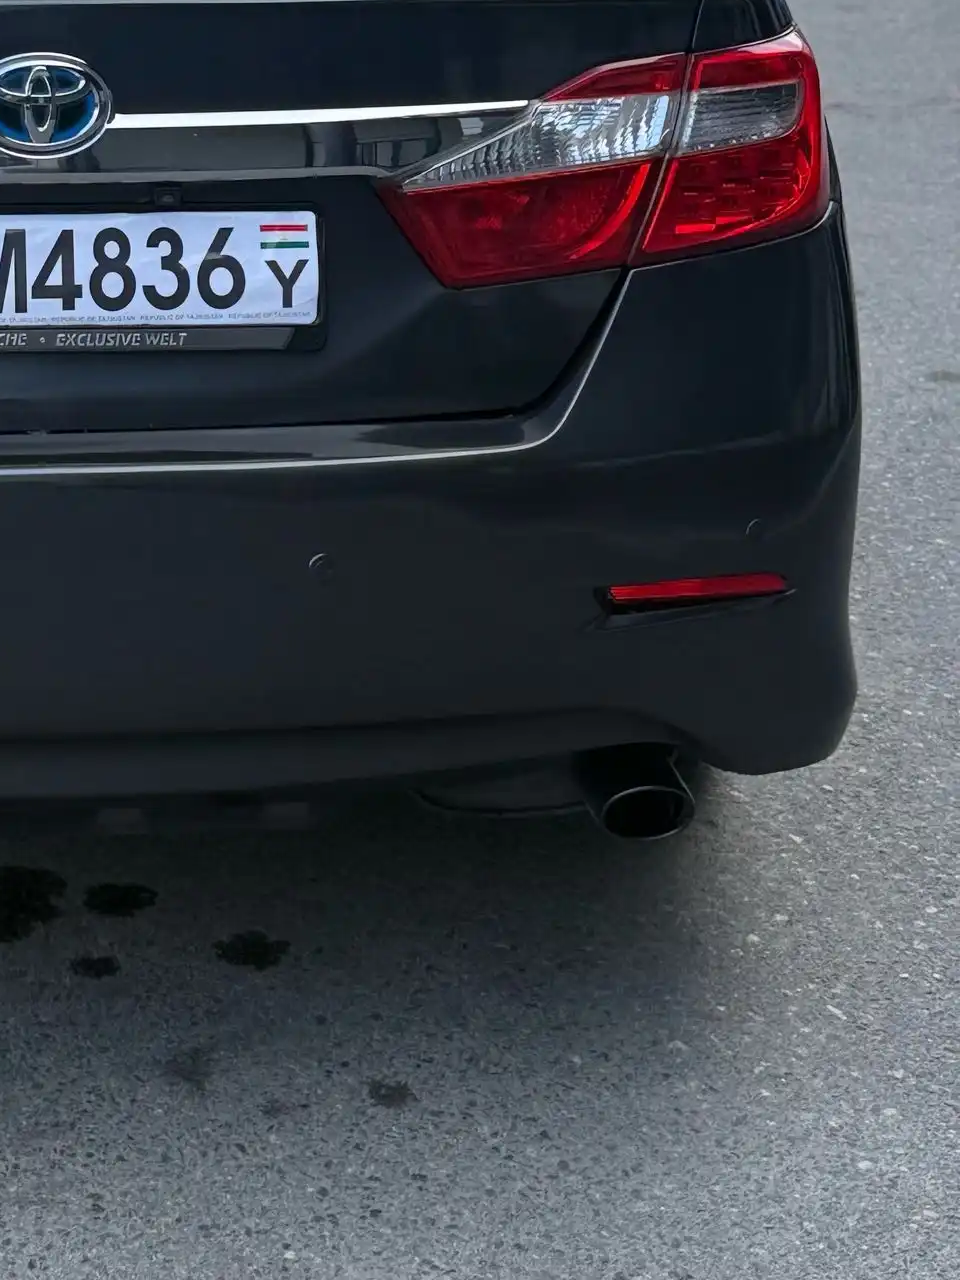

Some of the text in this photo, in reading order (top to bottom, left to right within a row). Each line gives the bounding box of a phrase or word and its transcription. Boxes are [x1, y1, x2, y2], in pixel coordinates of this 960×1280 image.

[264, 258, 308, 309] Y
[55, 332, 141, 347] EXCLUSIVE
[145, 332, 188, 347] WELT
